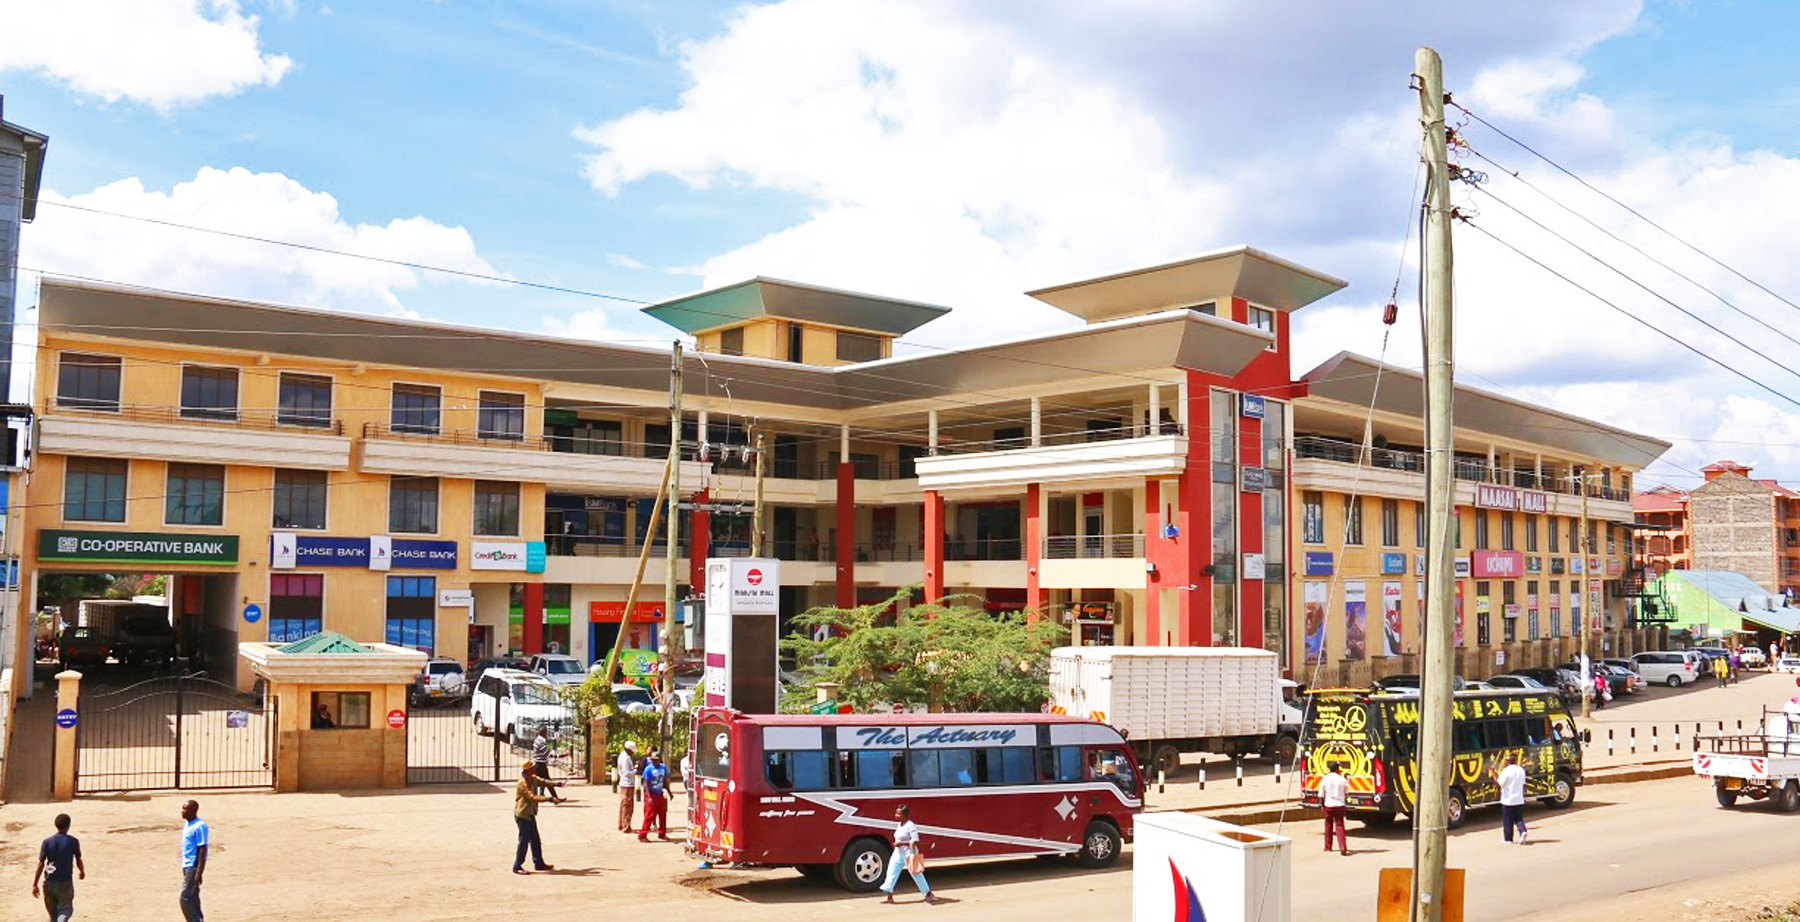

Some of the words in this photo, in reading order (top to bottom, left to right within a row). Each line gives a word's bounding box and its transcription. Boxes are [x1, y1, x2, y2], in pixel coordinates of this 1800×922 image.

[1480, 487, 1514, 509] MAASAI
[1525, 493, 1545, 511] MALL
[81, 539, 182, 553] CO-OPERATIVE
[184, 542, 223, 554] BANK
[296, 547, 333, 556] CHASE
[337, 548, 366, 556] BANK
[392, 549, 427, 558] CHASE
[428, 551, 457, 559] BANK
[593, 606, 615, 617] Housing
[856, 727, 905, 746] The
[909, 726, 1017, 745] Actuary
